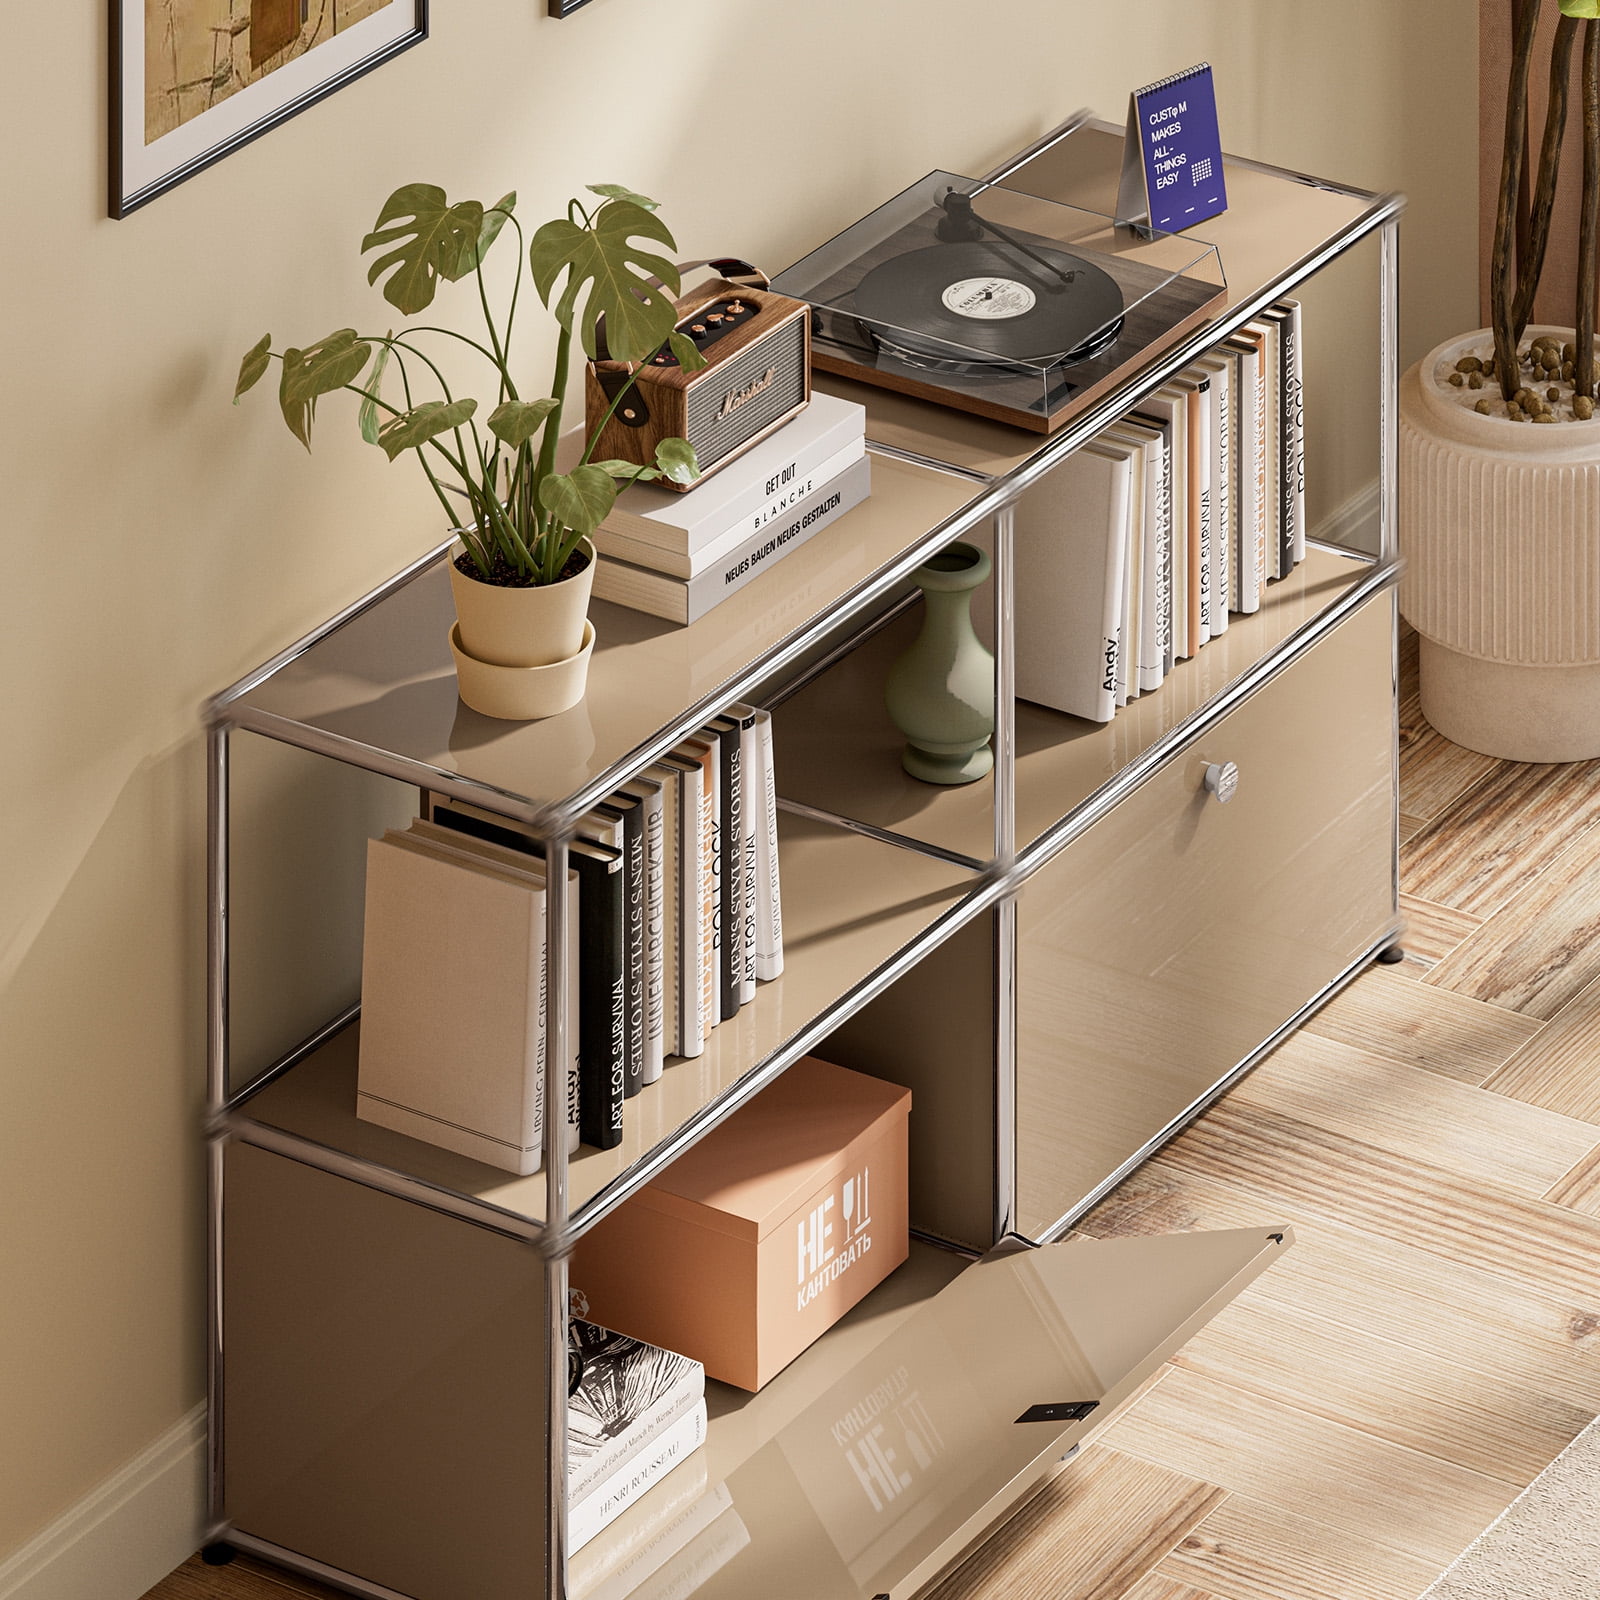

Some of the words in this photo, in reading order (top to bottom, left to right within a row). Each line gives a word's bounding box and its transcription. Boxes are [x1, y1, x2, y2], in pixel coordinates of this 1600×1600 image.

[1151, 121, 1182, 143] MAKES
[1153, 147, 1170, 160] ALL
[1154, 153, 1187, 175] THINGS
[1156, 171, 1179, 190] EASY
[1285, 332, 1295, 420] STORIES
[766, 474, 780, 495] GET
[782, 462, 796, 484] OUT
[1285, 424, 1295, 481] STYLE
[754, 480, 812, 528] BLANCHE
[1285, 486, 1295, 549] MEN'S
[725, 558, 750, 585] NEUES
[751, 538, 776, 566] BAUEN
[776, 521, 800, 547] NEUES
[802, 491, 841, 529] GESTALTEN
[1201, 563, 1210, 595] FOR
[1201, 602, 1210, 626] ART
[1103, 638, 1118, 692] Andy
[730, 747, 741, 842] STORIES
[630, 831, 643, 904] MEN'S
[730, 843, 741, 914] STYLE
[745, 830, 756, 908] SURVIVAL
[630, 908, 643, 977] STYLE
[647, 807, 663, 1042] INNENARCHITEKTUR
[730, 917, 741, 989] MEN'S
[745, 912, 756, 949] FOR
[745, 953, 756, 983] ART
[611, 973, 623, 1054] SURVIVAL
[630, 980, 643, 1077] STORIES
[534, 1078, 544, 1133] IRVING
[611, 1059, 623, 1096] FOR
[611, 1100, 623, 1130] ART
[798, 1194, 835, 1285] НЕ
[797, 1232, 872, 1312] КАНТОВАТЬ
[600, 1482, 628, 1517] HENRI
[631, 1441, 679, 1490] ROUSSEAU
